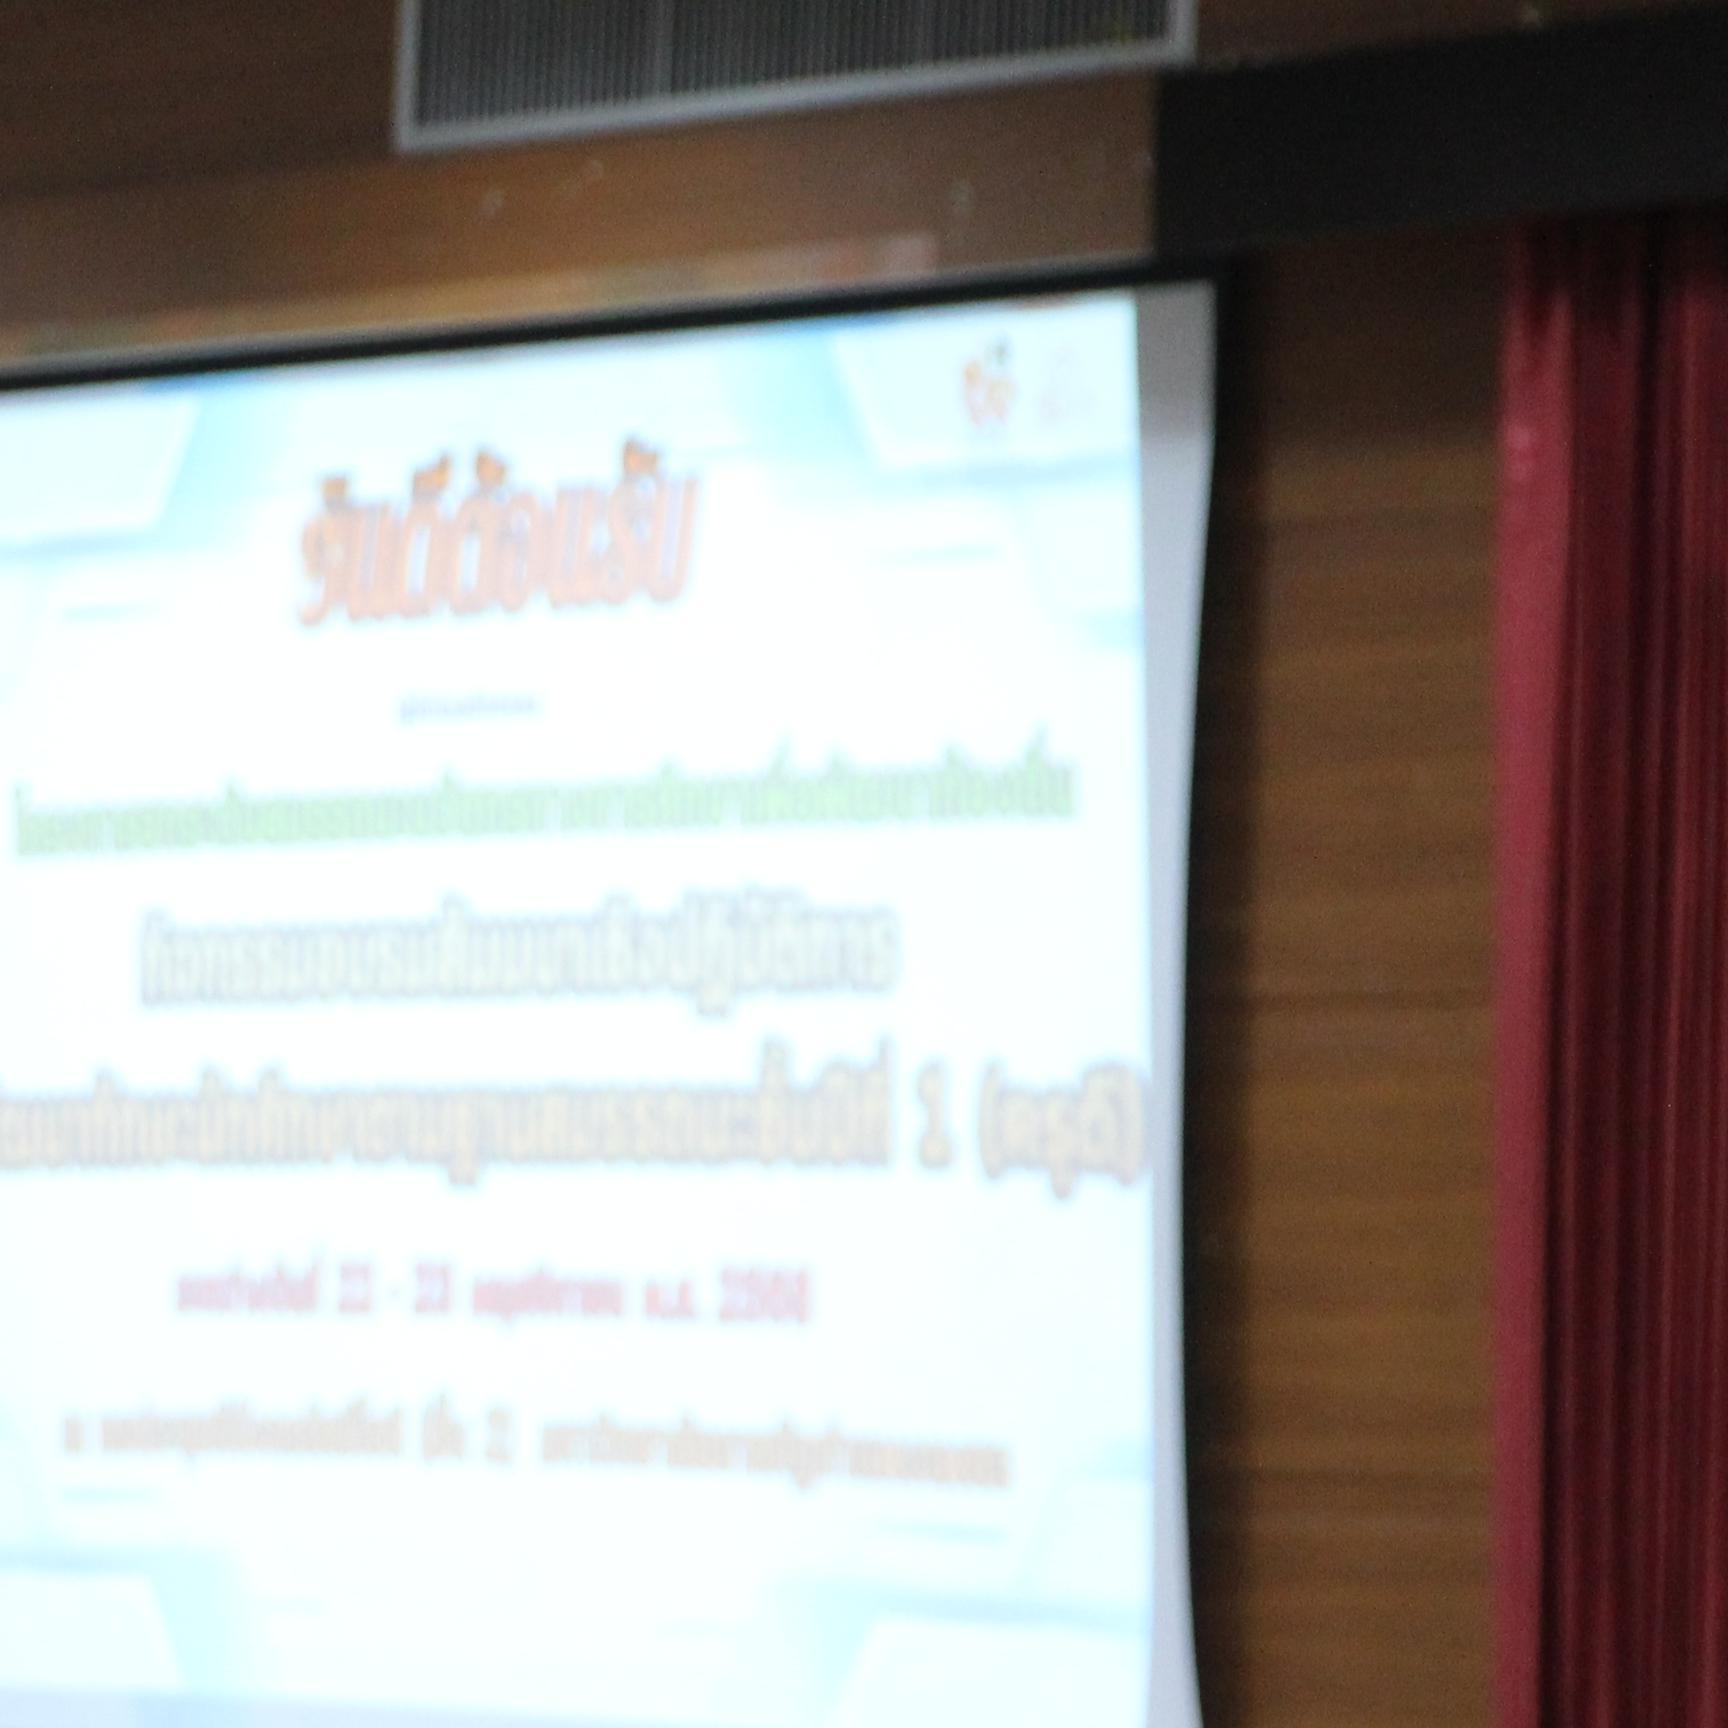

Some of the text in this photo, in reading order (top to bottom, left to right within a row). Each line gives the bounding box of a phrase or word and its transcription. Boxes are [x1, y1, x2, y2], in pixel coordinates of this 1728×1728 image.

[300, 437, 701, 628] ยินดีต้อนรับ
[919, 1062, 950, 1168] 1
